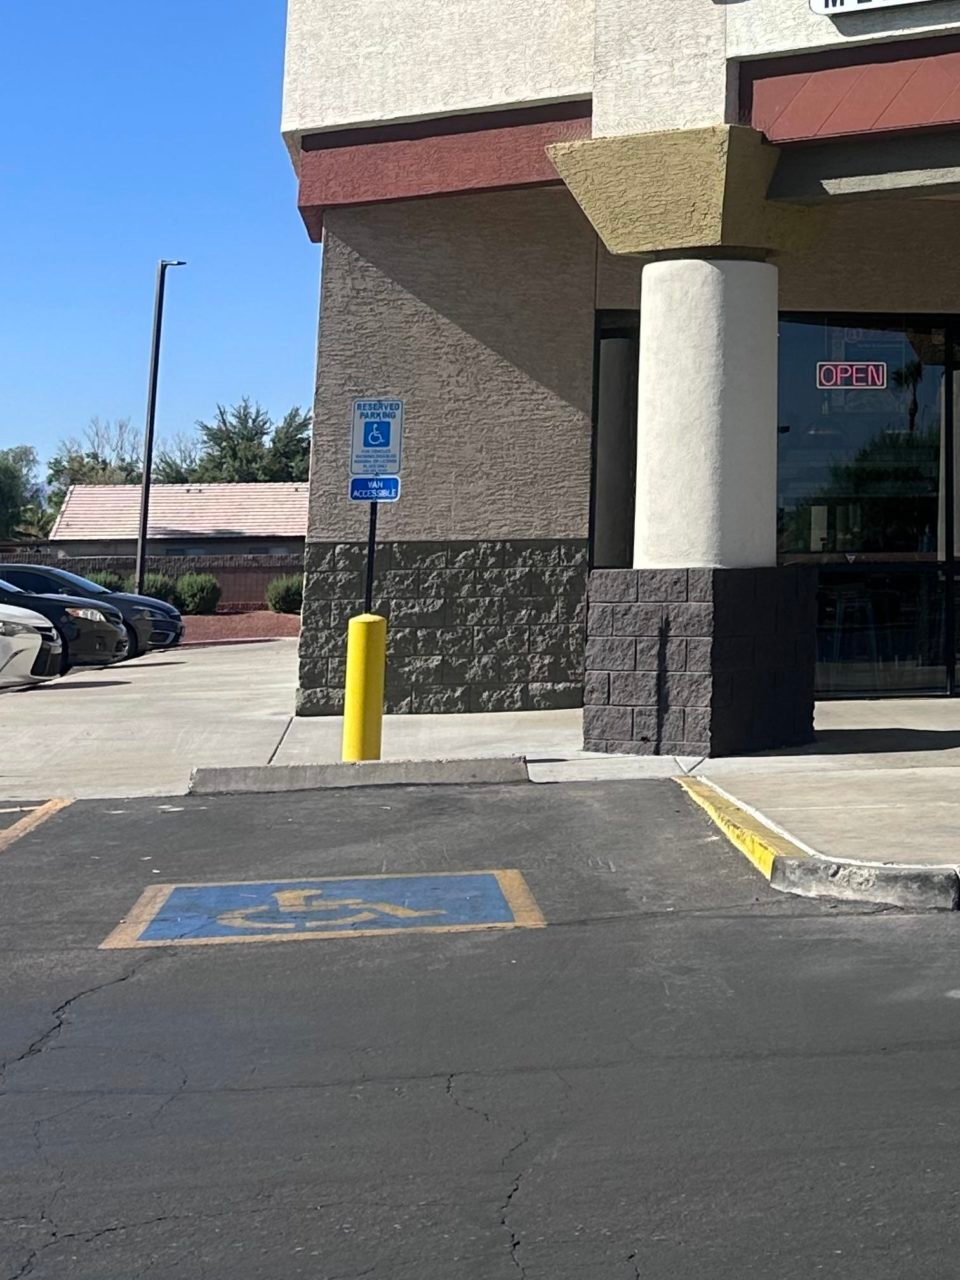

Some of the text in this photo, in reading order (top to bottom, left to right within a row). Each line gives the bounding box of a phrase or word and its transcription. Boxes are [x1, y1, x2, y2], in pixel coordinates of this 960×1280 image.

[819, 364, 884, 386] OPEN
[356, 403, 400, 411] RESERVED
[359, 411, 397, 420] PARKING
[367, 480, 384, 489] VAN
[352, 488, 397, 498] ACCESSIBLE
